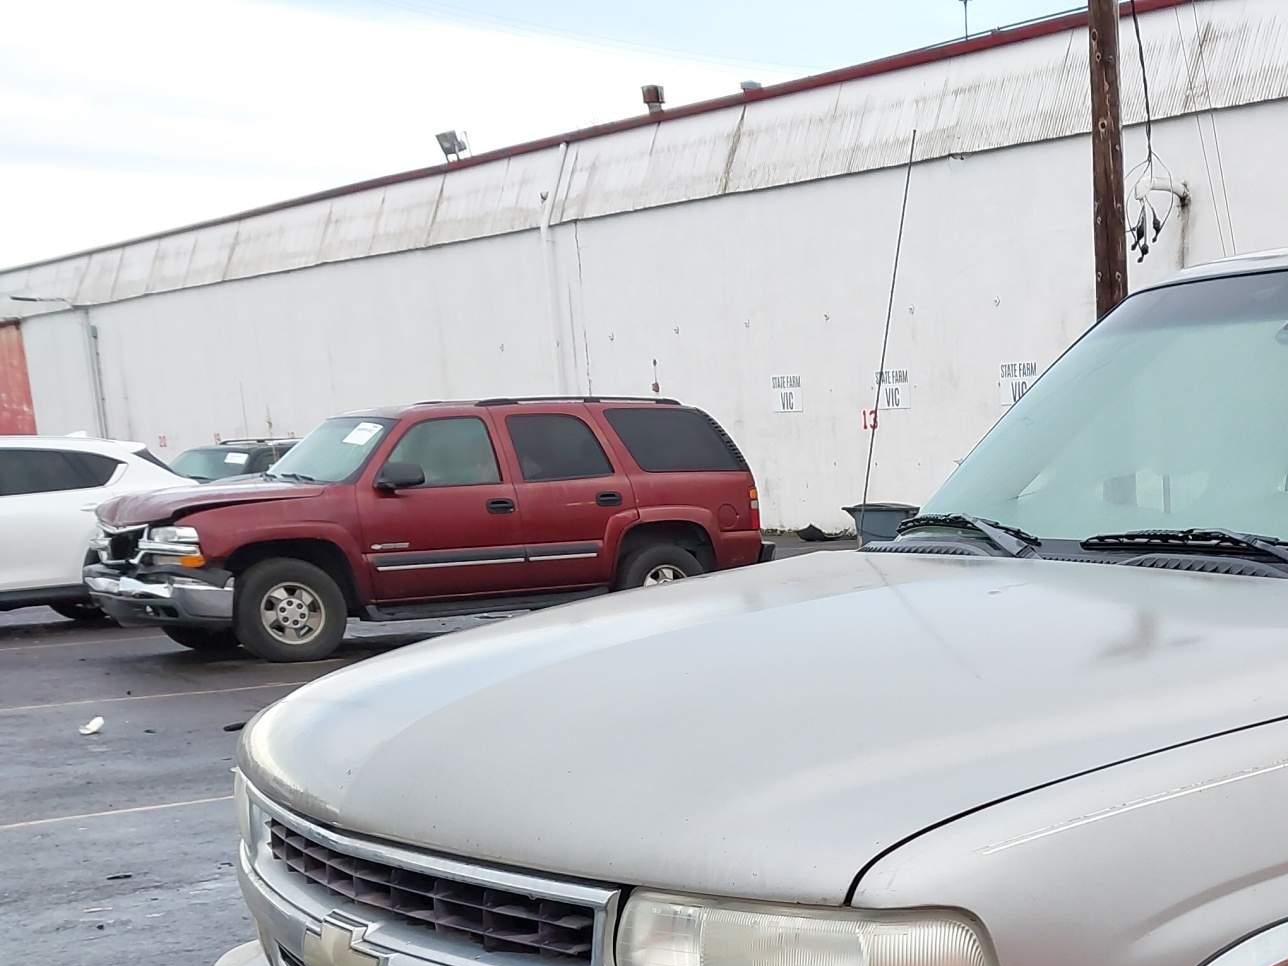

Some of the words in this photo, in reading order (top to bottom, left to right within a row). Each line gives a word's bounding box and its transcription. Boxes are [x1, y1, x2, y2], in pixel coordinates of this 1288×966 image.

[875, 370, 891, 384] STATE
[891, 370, 909, 384] FARM
[1000, 363, 1018, 378] STATE
[1018, 362, 1037, 377] FARM
[771, 376, 786, 389] STATE
[786, 375, 801, 388] FARM
[780, 391, 794, 410] VIC
[885, 387, 900, 407] VIC
[862, 409, 879, 430] 13
